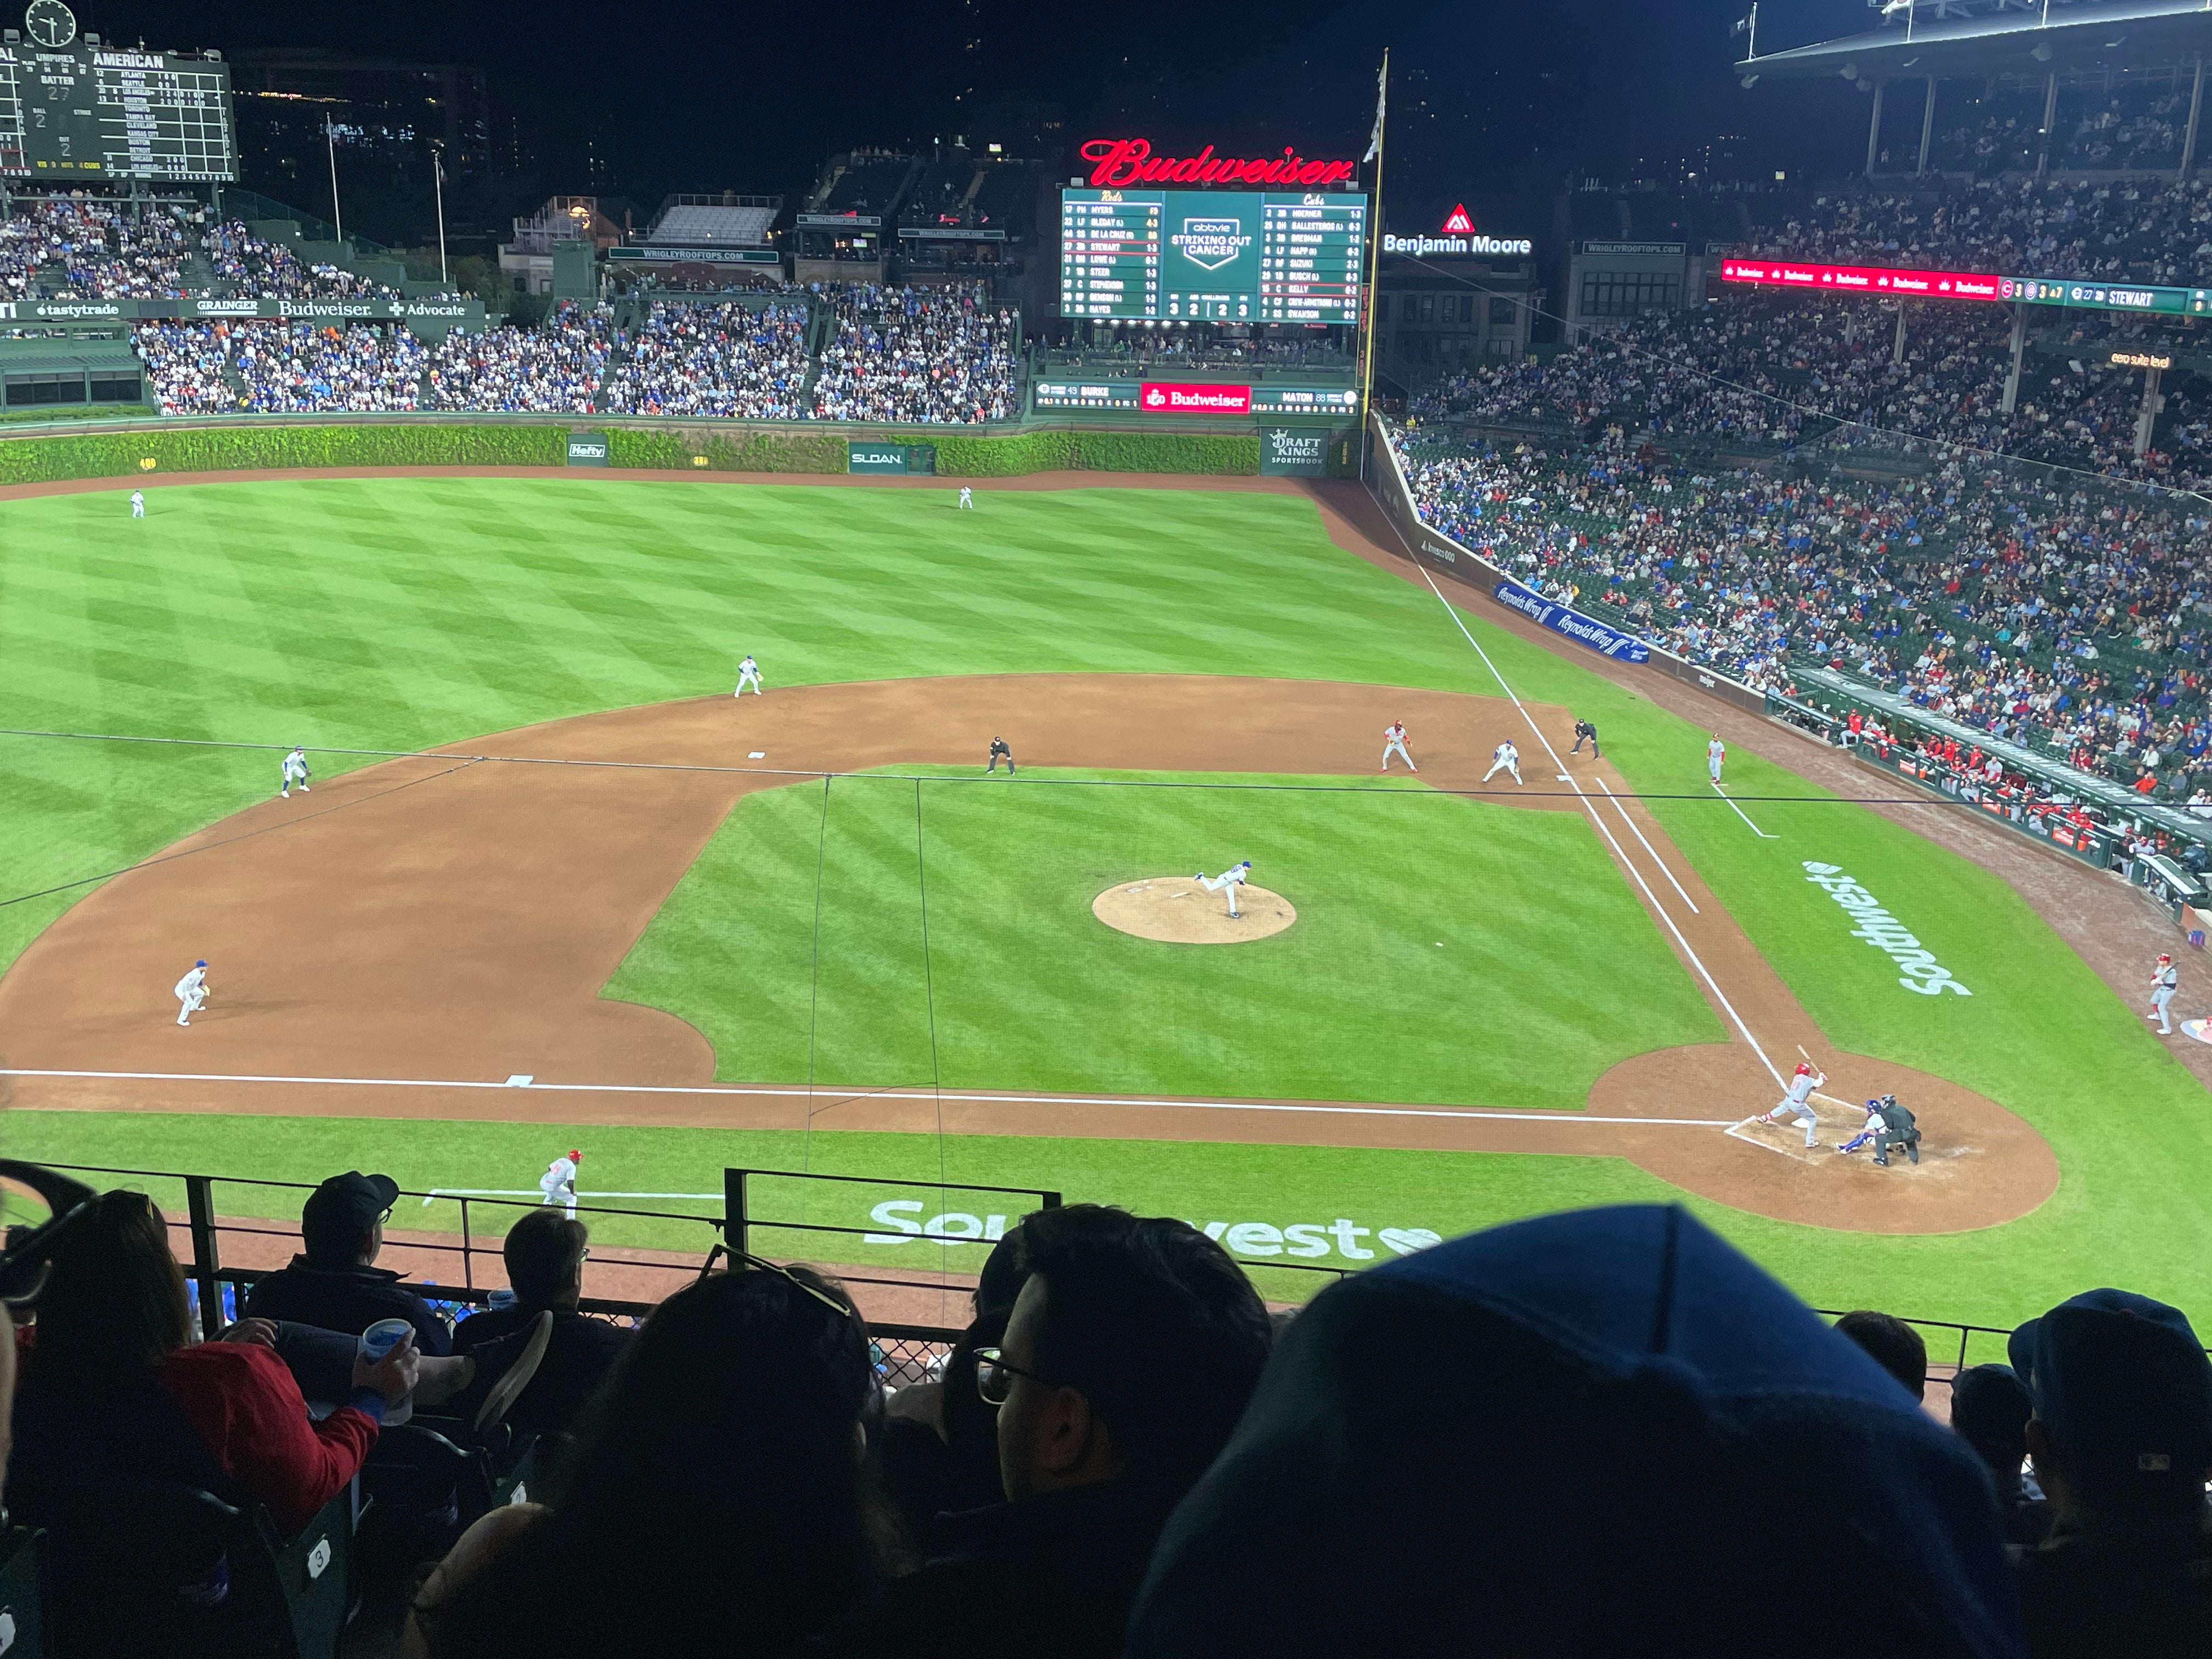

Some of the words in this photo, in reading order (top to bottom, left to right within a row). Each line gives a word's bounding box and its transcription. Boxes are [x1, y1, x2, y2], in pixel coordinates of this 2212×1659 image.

[36, 53, 76, 64] UMPIRES
[93, 52, 164, 69] AMERICAN
[41, 75, 75, 85] BATTER
[36, 114, 46, 128] 2
[61, 143, 71, 156] 2
[1080, 138, 1353, 185] Budweiser
[1102, 190, 1123, 202] Reds
[1304, 194, 1325, 206] Cubs
[1194, 224, 1230, 233] abbvie
[1172, 235, 1227, 245] STRIKING
[1228, 236, 1252, 246] OUT
[1384, 234, 1467, 256] Benjamin
[1472, 236, 1532, 253] Moore
[1091, 243, 1121, 252] STEWART
[1188, 245, 1234, 255] CANCER
[1291, 247, 1308, 256] HAPP
[1588, 244, 1680, 253] WRIGLEYROOFTOPS.COM
[643, 249, 743, 259] WRIGLEYROOFTOPS.COM
[1290, 259, 1313, 268] SUZUKI
[1836, 273, 1869, 286] Budweiser
[1893, 276, 1928, 290] Budweiser
[1276, 284, 1282, 293] C
[1288, 285, 1309, 294] KELLY
[1955, 281, 1995, 295] Budweiser
[2015, 283, 2022, 297] 3
[2039, 285, 2046, 299] 3
[2108, 291, 2153, 306] STEWART
[47, 303, 119, 318] tastytrade
[197, 300, 257, 310] GRAINGER
[278, 301, 370, 316] Budweiser
[407, 303, 465, 315] Advocate
[1089, 305, 1111, 314] HAYES
[1170, 303, 1179, 315] 3
[1190, 303, 1199, 315] 2
[1218, 304, 1228, 317] 2
[1239, 304, 1248, 317] 3
[2151, 356, 2170, 368] level
[1081, 386, 1109, 397] BURKE
[1171, 391, 1245, 407] Budweiser
[1272, 437, 1321, 449] DRAFT
[571, 445, 603, 455] Hefty
[1277, 446, 1319, 456] KINGS
[851, 453, 901, 464] SLOAN
[1272, 456, 1323, 465] SPORTSBOOK
[1497, 586, 1525, 610] Reynolds
[1523, 597, 1543, 620] Wrap
[1558, 614, 1594, 639] Reynolds
[1592, 628, 1615, 649] Wrap
[1805, 875, 1973, 996] Southwest
[315, 1550, 324, 1568] 3
